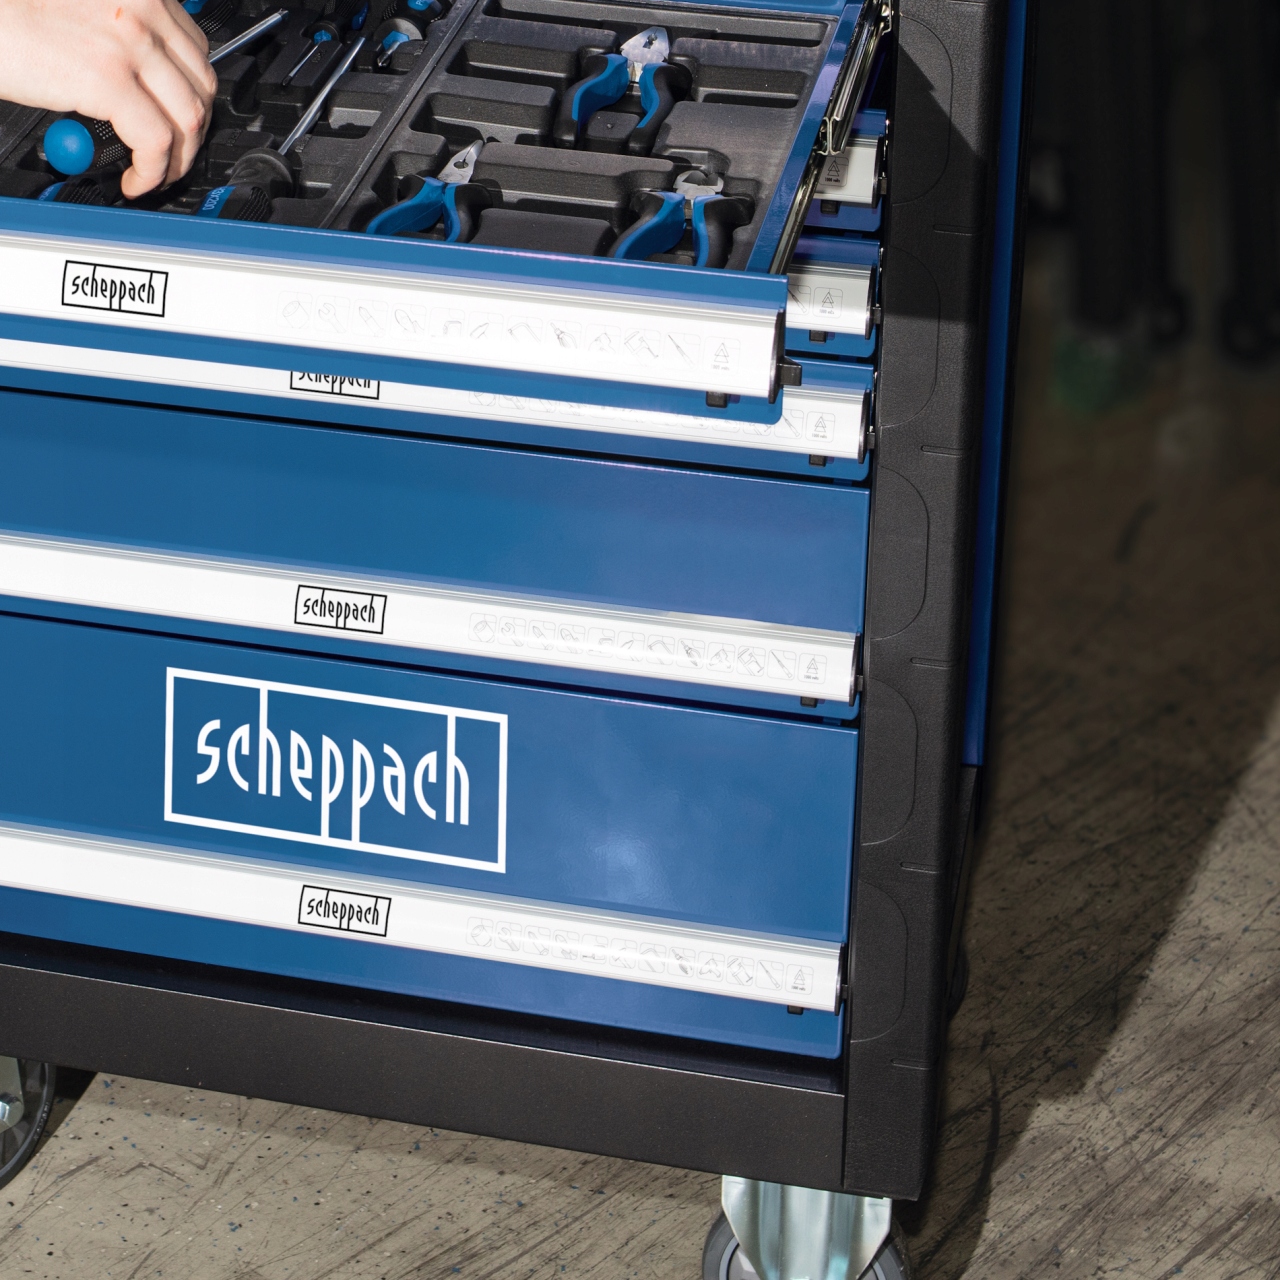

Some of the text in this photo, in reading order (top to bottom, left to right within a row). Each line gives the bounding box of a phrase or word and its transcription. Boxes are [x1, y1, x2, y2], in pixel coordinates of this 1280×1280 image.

[72, 263, 156, 311] scheppach
[304, 588, 376, 631] scheppach
[197, 685, 469, 845] scheppach
[308, 889, 380, 931] scheppach
